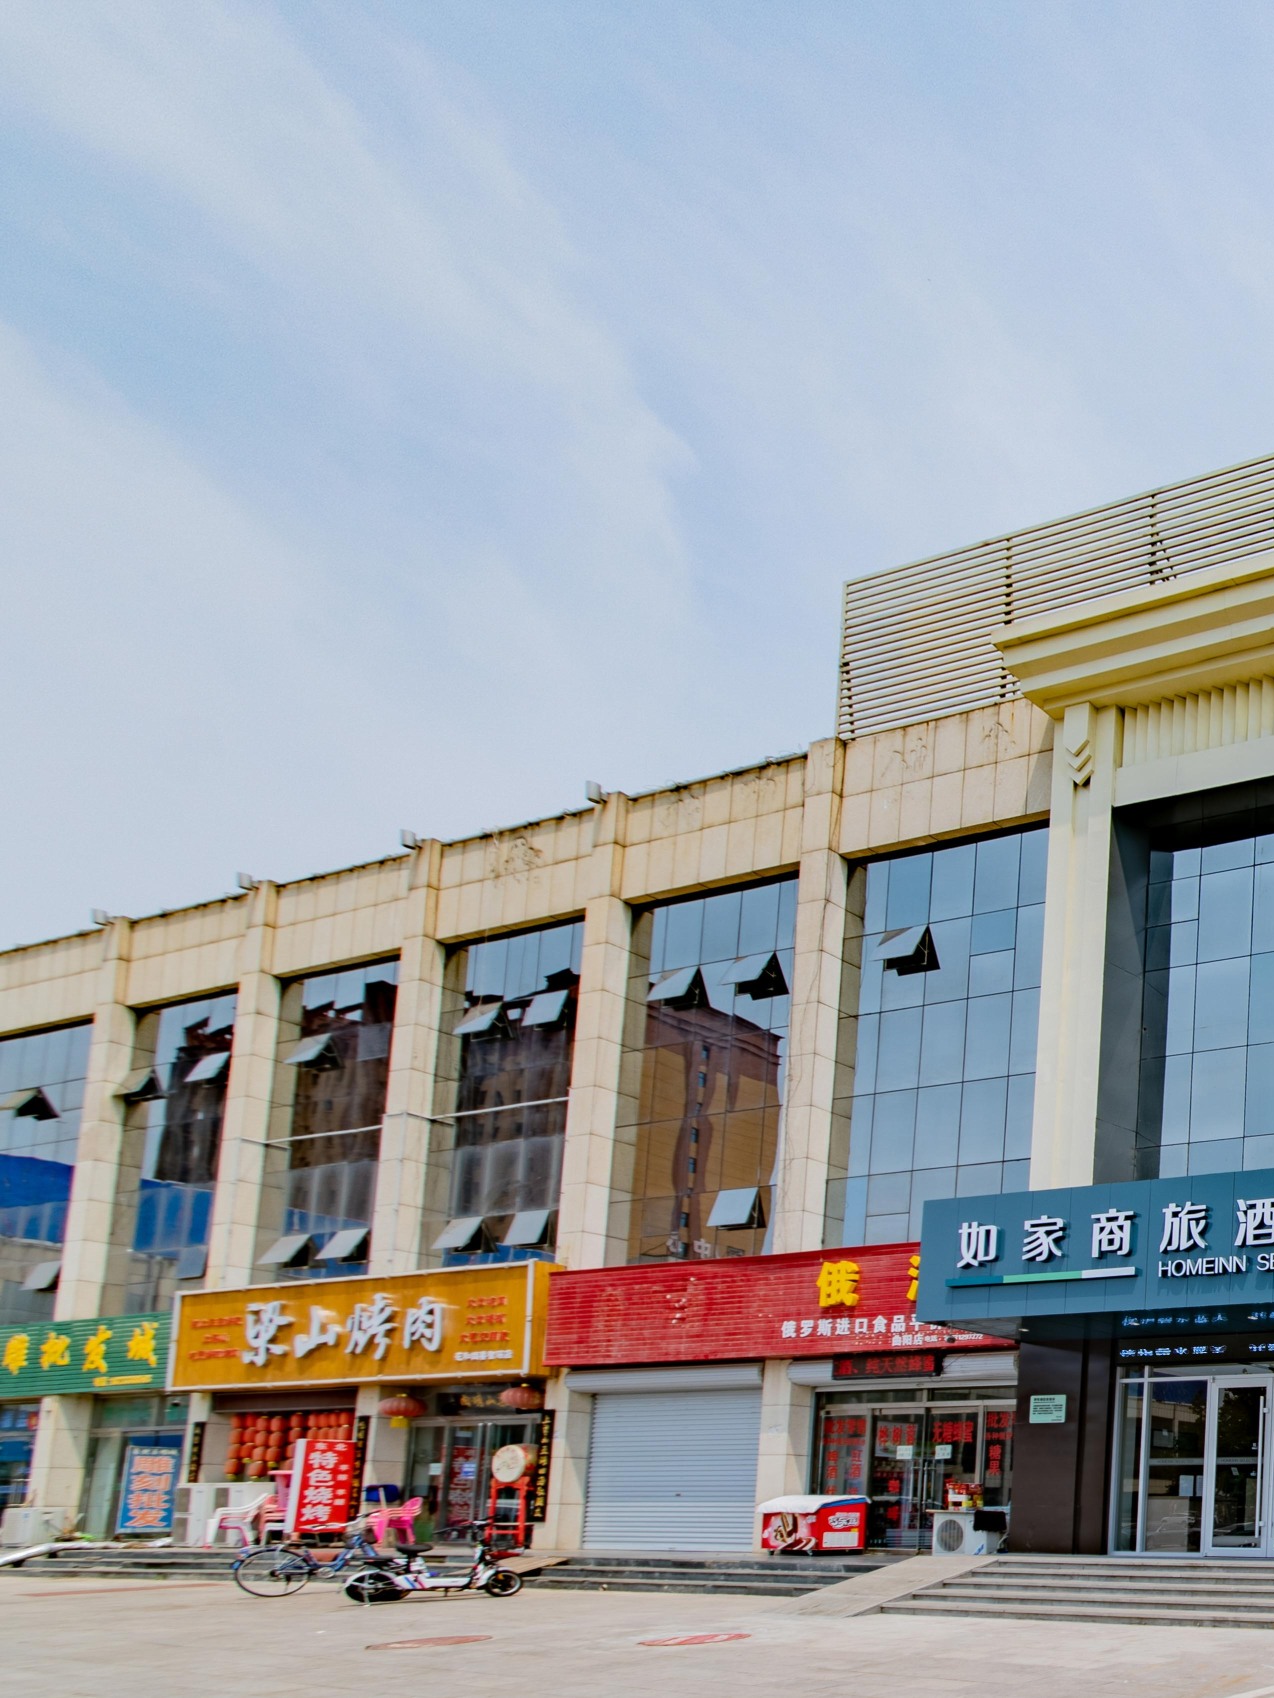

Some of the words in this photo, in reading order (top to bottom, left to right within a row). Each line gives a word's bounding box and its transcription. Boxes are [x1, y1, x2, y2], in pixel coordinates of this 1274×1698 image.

[1158, 1255, 1247, 1277] HOMEINN
[242, 1293, 446, 1366] 梁山烤肉
[300, 1451, 340, 1522] 特色烧烤
